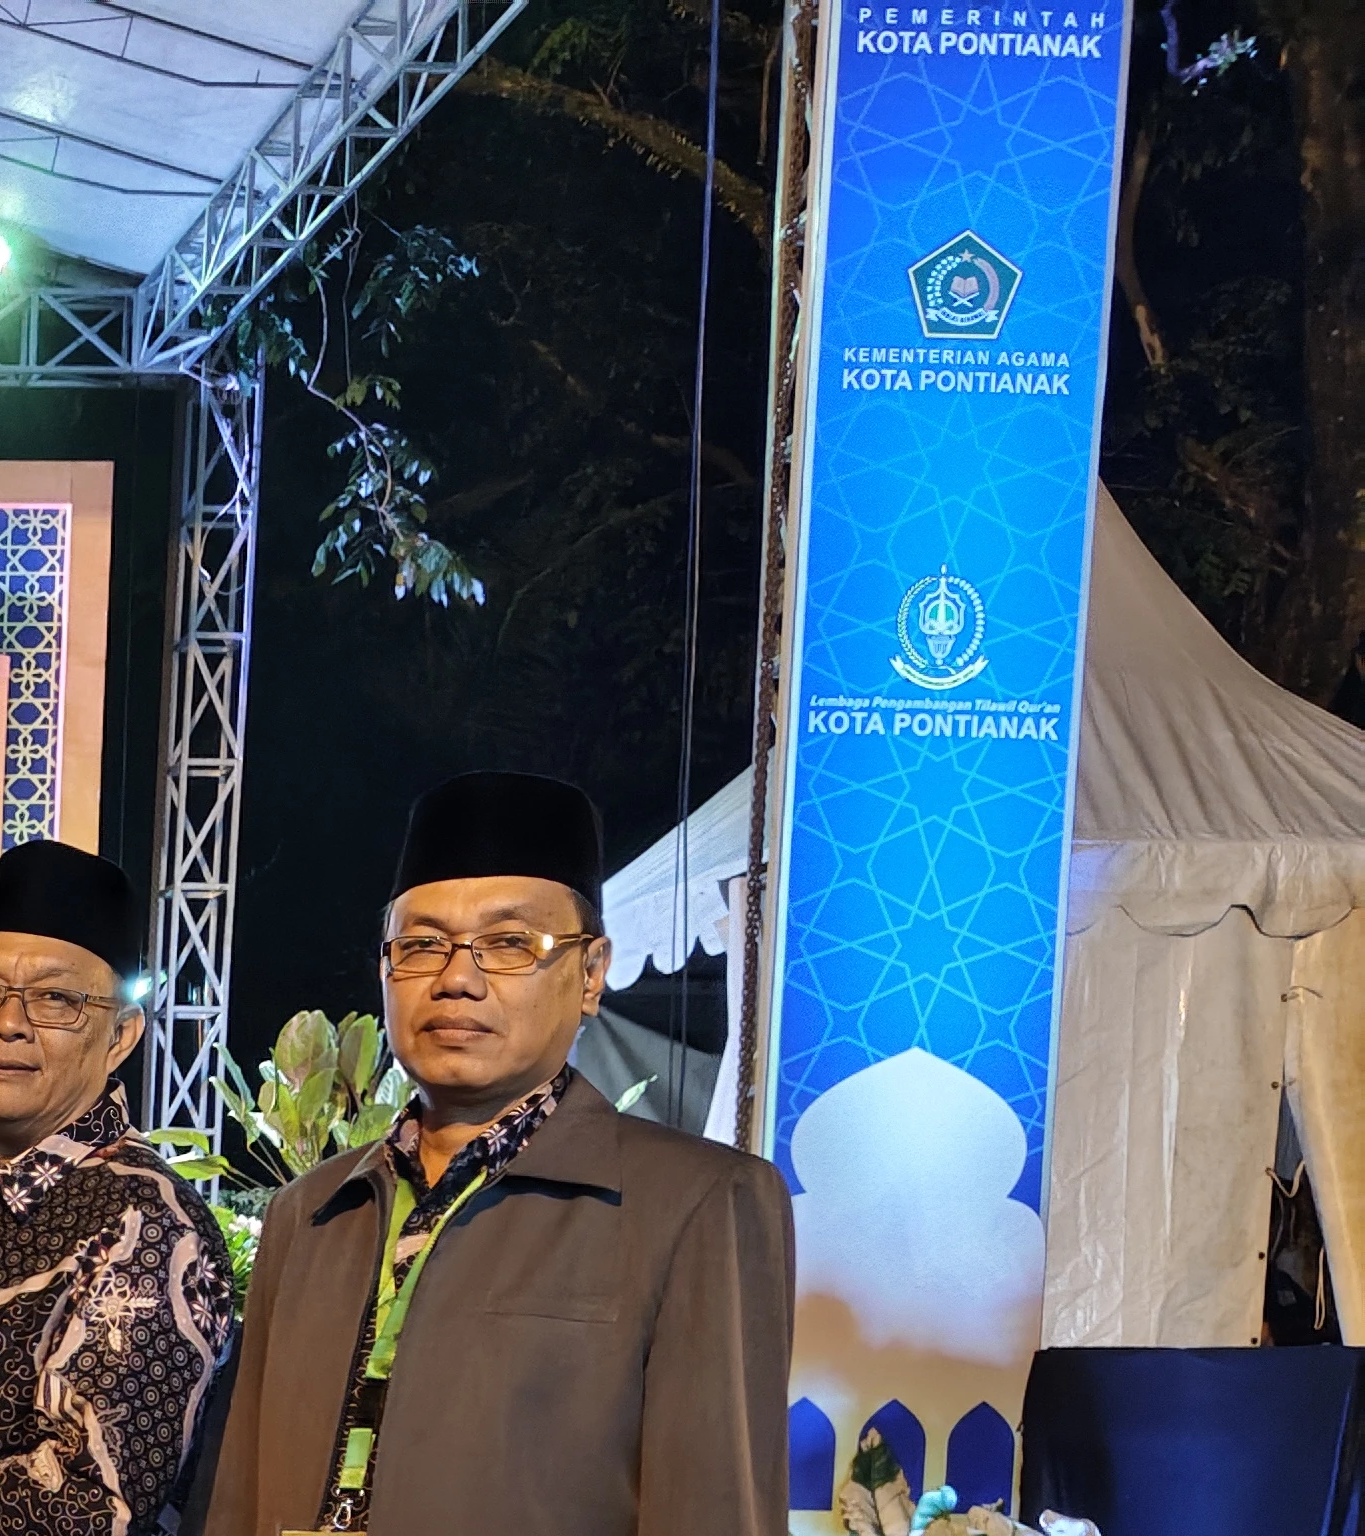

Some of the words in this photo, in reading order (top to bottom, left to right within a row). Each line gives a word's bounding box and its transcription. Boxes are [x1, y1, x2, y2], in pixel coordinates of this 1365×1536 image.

[859, 8, 1105, 28] PEMERINTAH
[857, 30, 933, 55] KOTA
[940, 32, 1102, 59] PONTIANAK
[844, 347, 990, 366] KEMENTERIAN
[997, 351, 1070, 368] AGAMA
[842, 368, 913, 391] KOTA
[919, 370, 1070, 395] PONTIANAK
[810, 694, 870, 710] Lembaga
[1018, 700, 1061, 714] Qur'an
[808, 710, 886, 735] KOTA
[893, 712, 1058, 741] PONTIANAK
